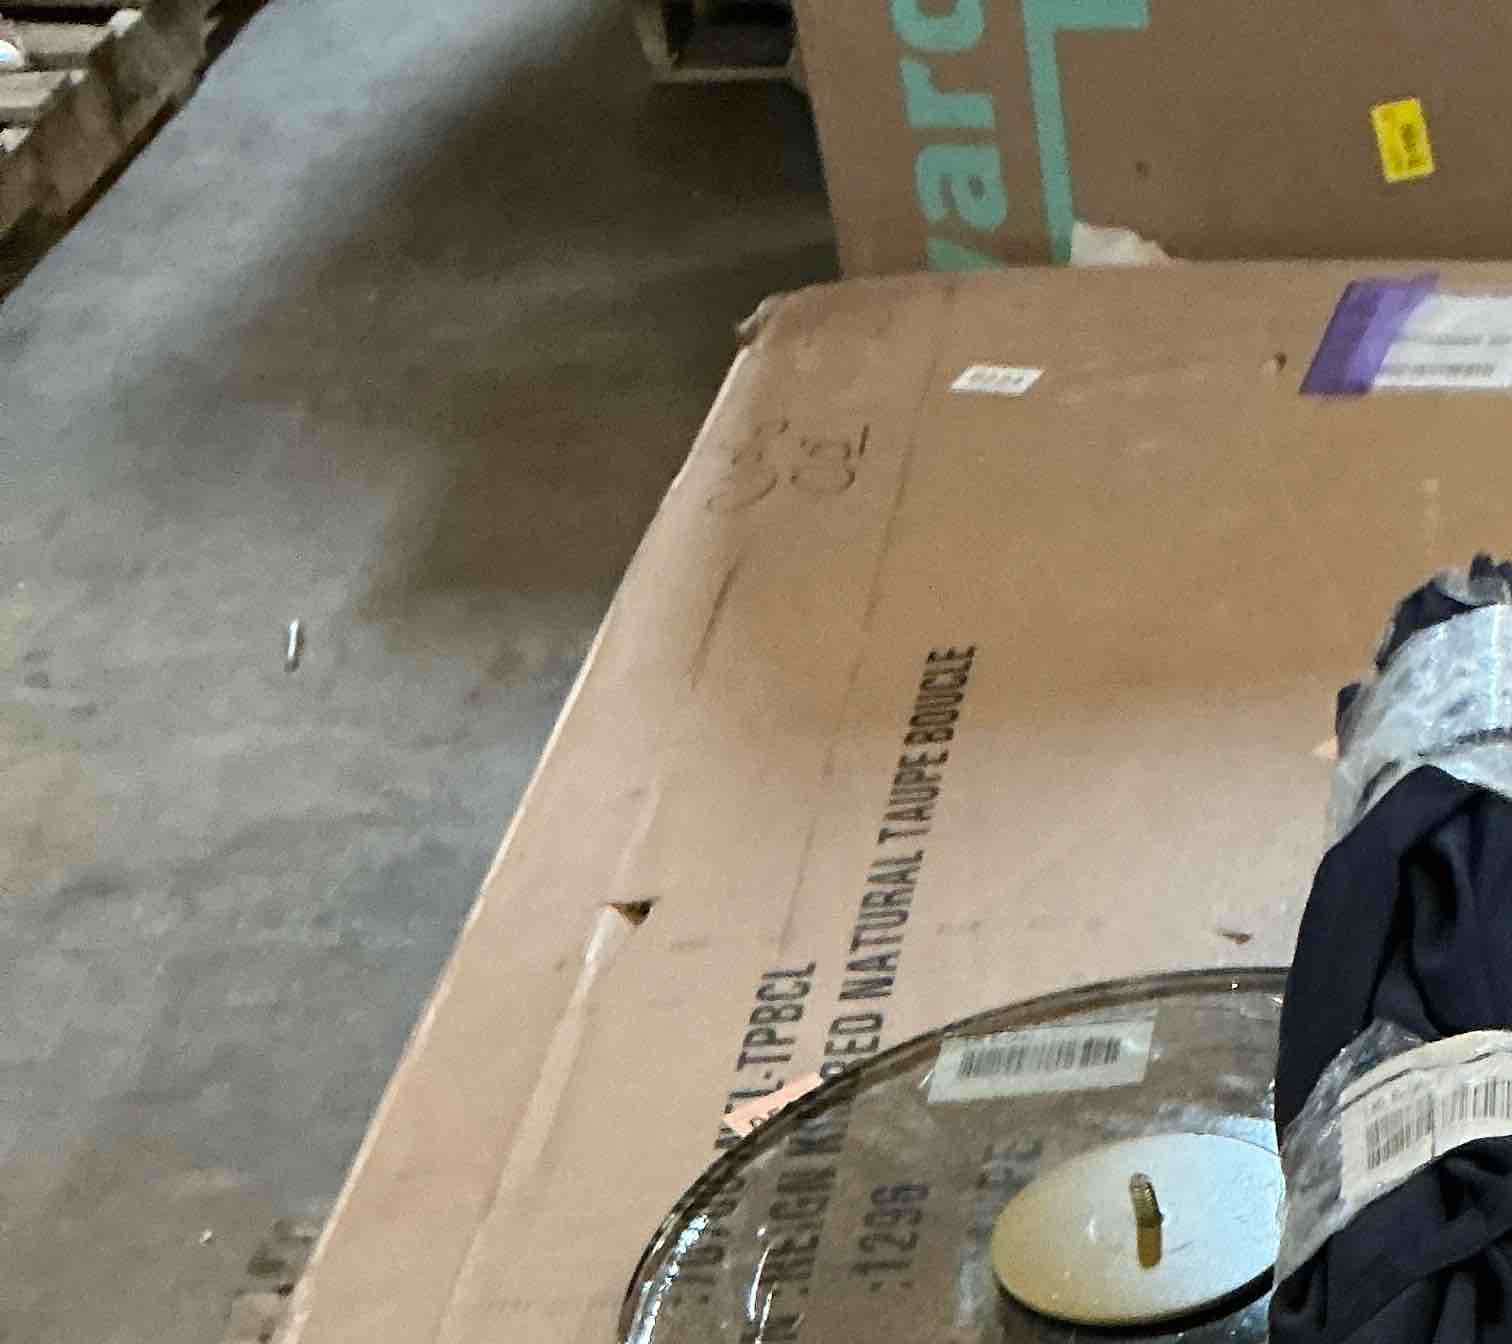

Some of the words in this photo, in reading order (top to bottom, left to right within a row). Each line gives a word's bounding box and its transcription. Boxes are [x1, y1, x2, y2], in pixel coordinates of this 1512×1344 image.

[903, 644, 976, 746] BOUCLE
[876, 750, 949, 844] TAUPE
[836, 850, 923, 999] NATURAL
